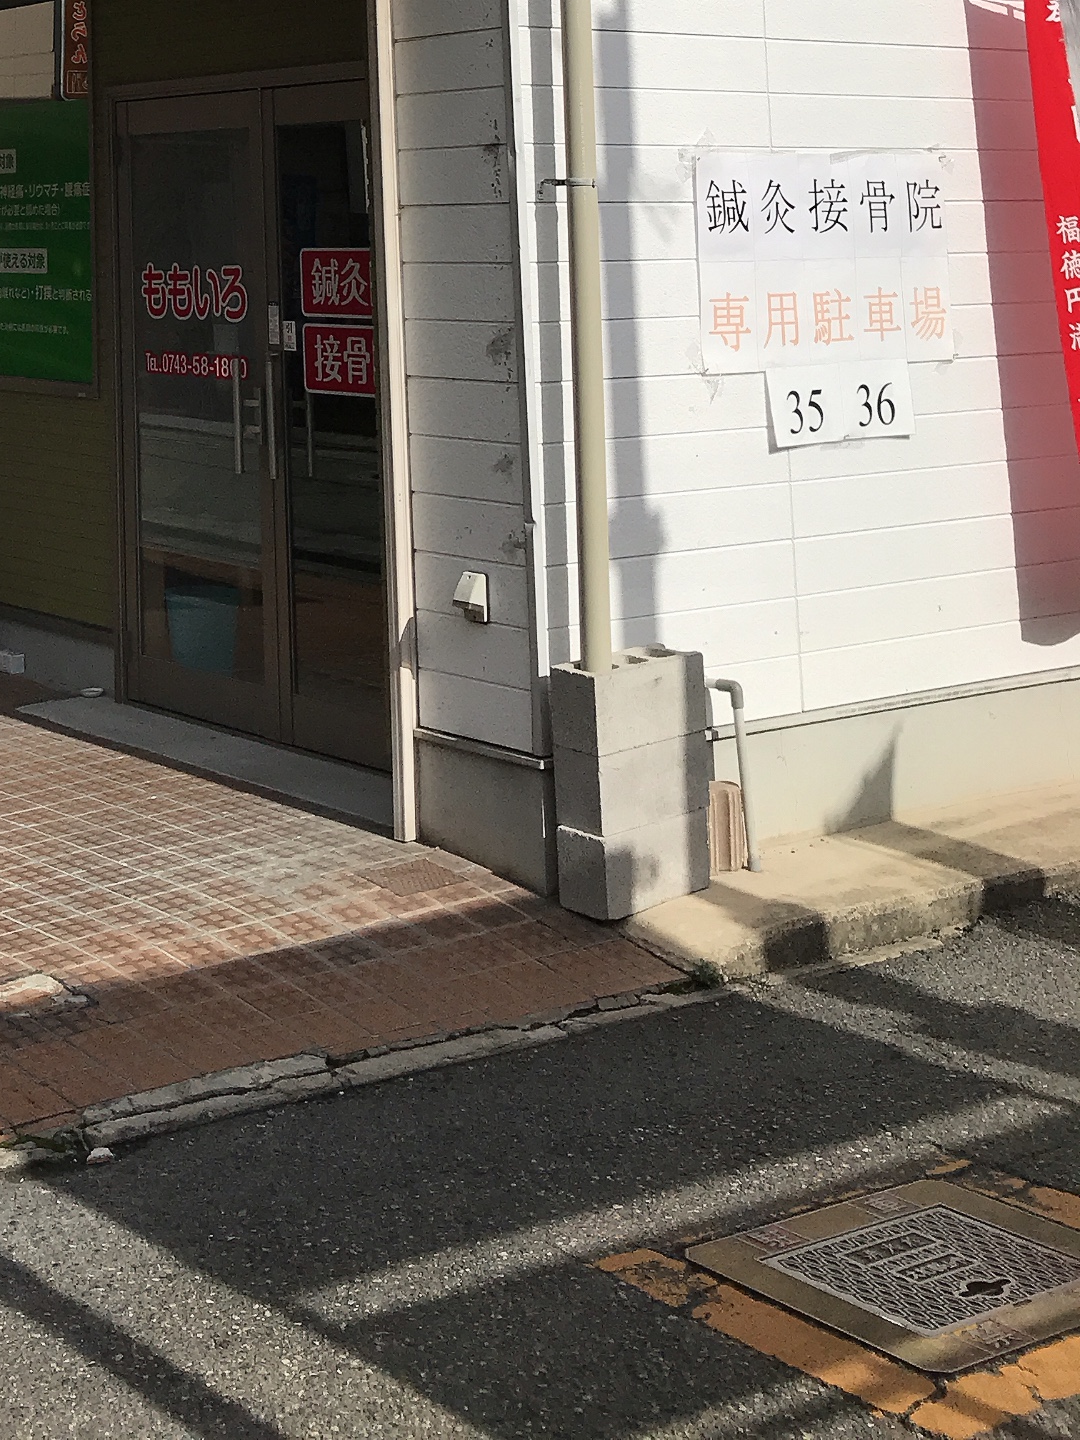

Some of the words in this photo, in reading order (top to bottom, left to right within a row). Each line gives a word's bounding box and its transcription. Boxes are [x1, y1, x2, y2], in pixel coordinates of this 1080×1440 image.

[705, 179, 943, 235] 鍼灸接骨院
[141, 262, 248, 323] ももいろ
[311, 258, 373, 307] 鍼灸
[708, 286, 948, 351] 専用駐車場
[314, 334, 376, 385] 接骨
[786, 389, 824, 434] 35
[856, 382, 896, 427] 36
